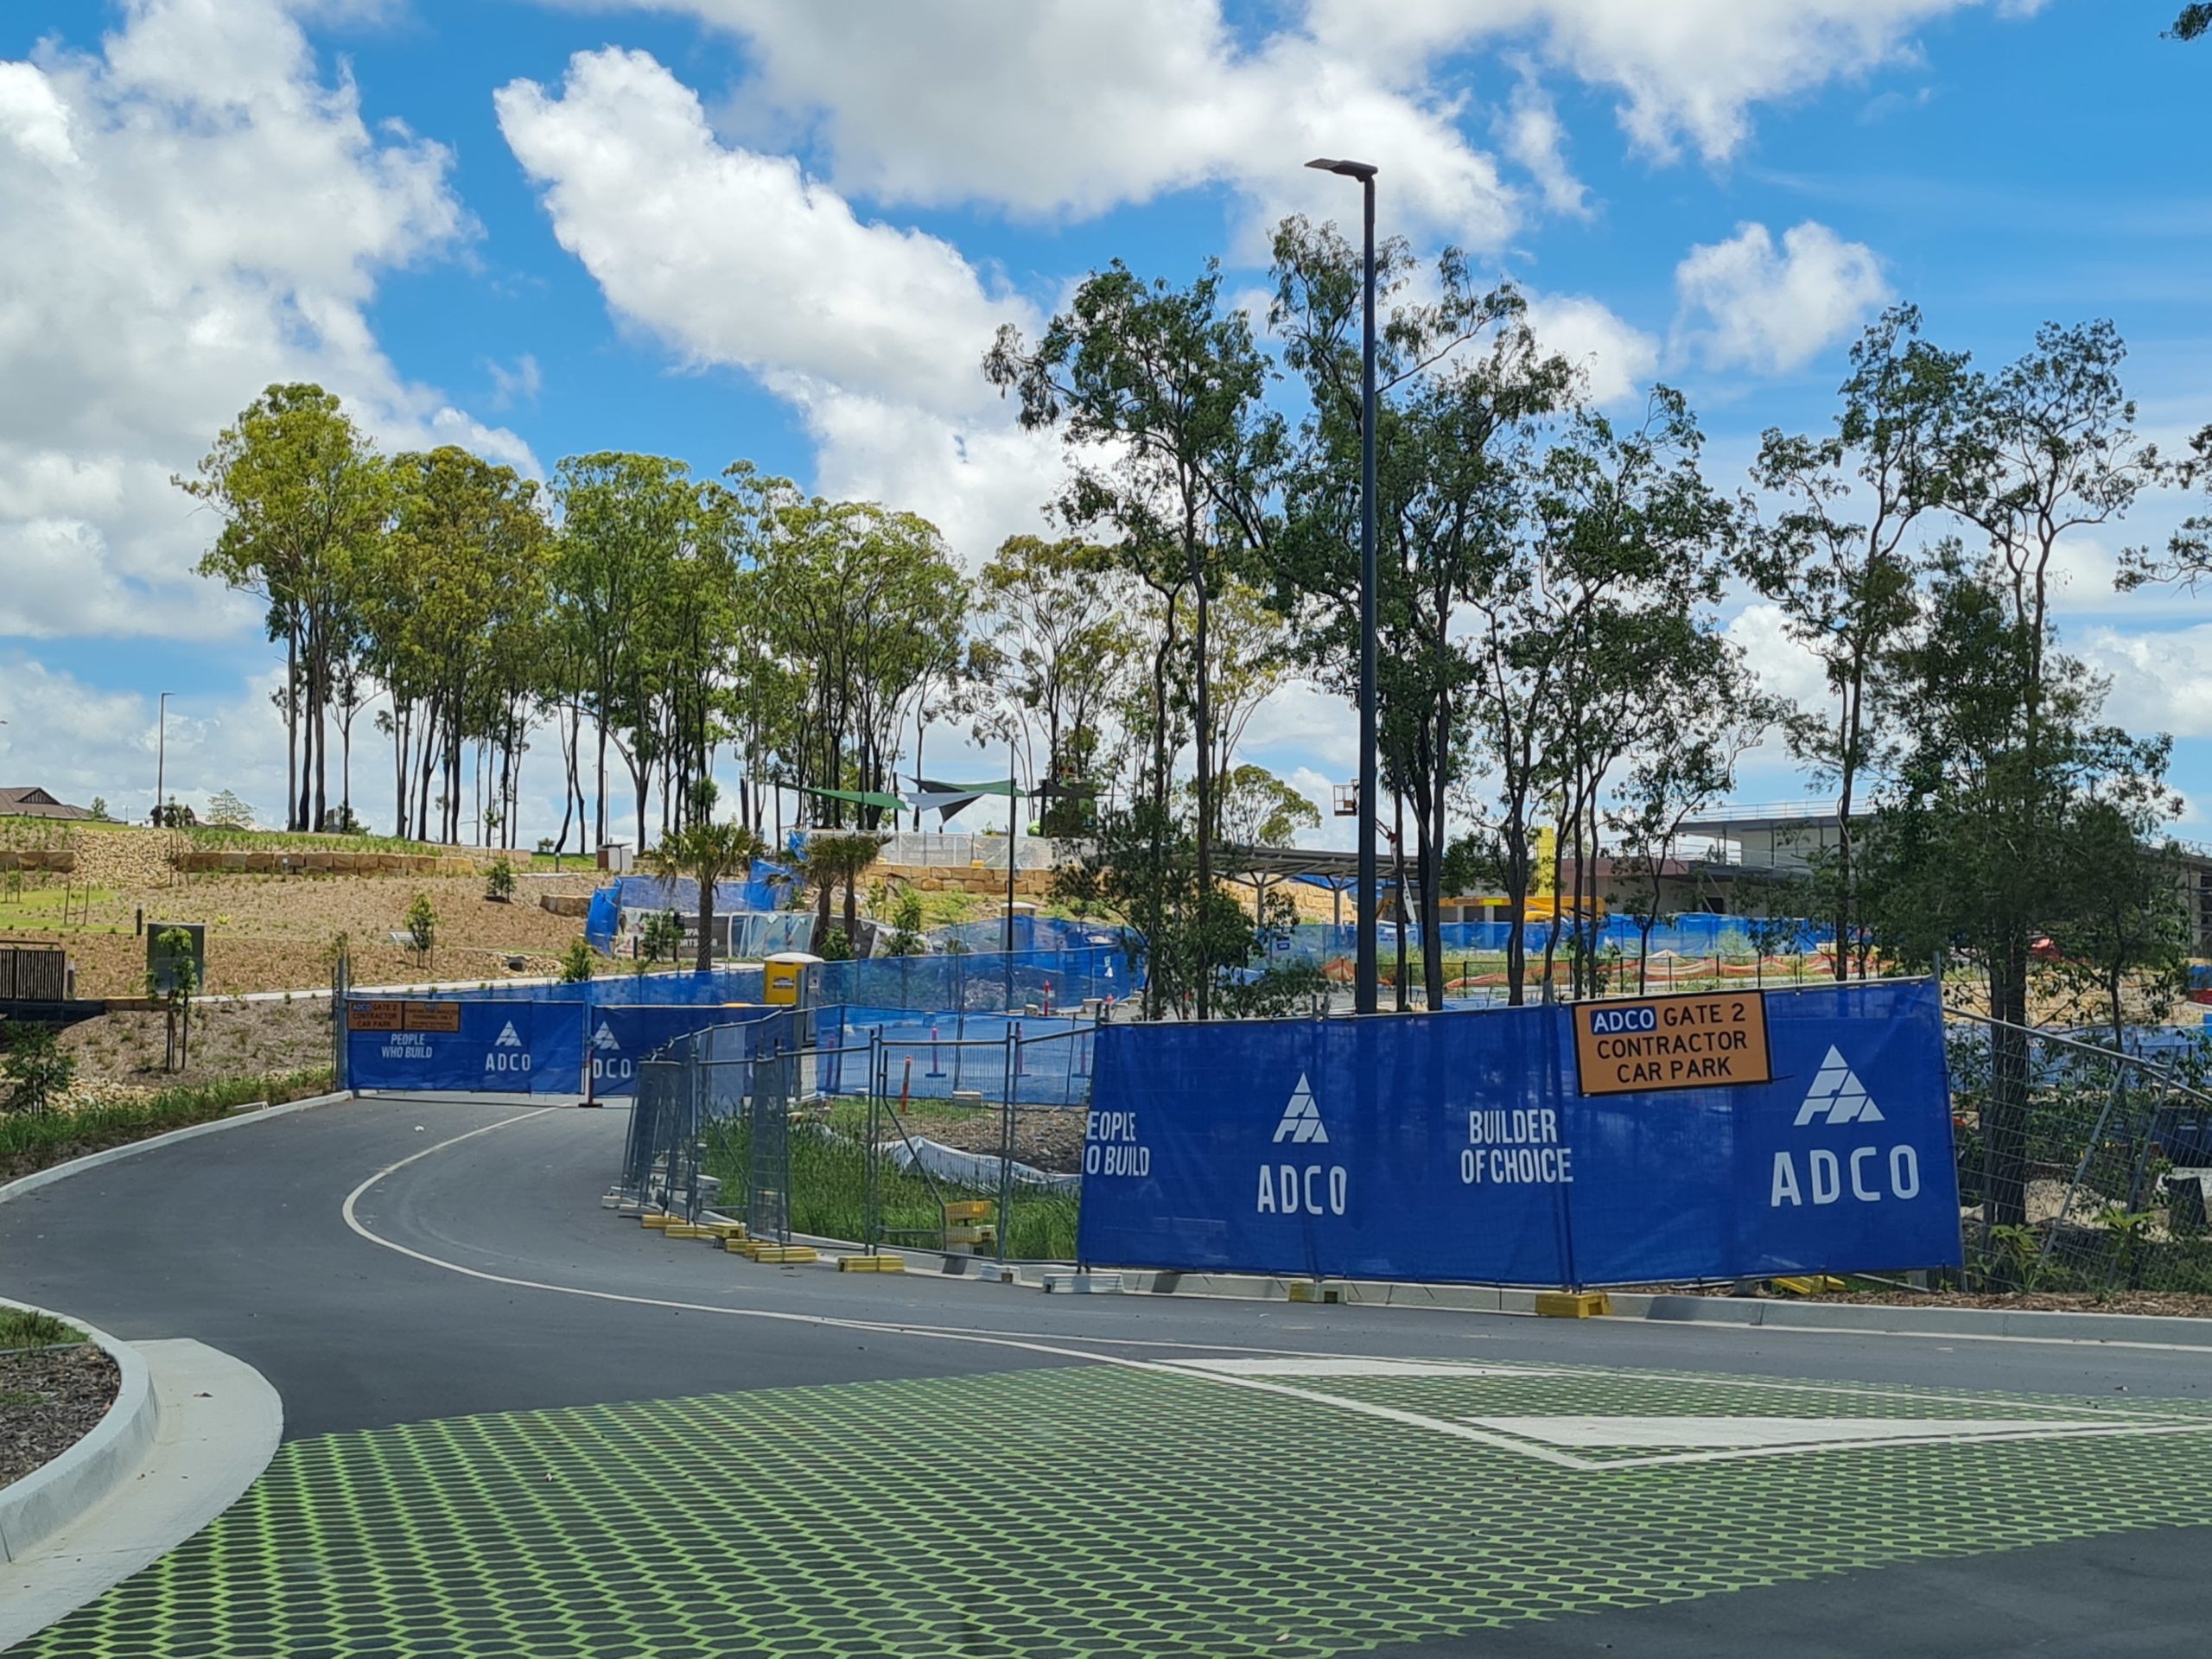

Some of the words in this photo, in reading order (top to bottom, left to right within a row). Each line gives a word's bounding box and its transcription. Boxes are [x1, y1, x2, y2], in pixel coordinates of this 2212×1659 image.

[1592, 1008, 1656, 1034] ADCO
[1663, 1003, 1724, 1027] GATE
[1731, 1002, 1746, 1022] 2
[381, 1046, 404, 1058] WHO
[404, 1046, 433, 1058] BUILD
[391, 1033, 426, 1046] PEOPLE
[1597, 1030, 1748, 1059] CONTRACTOR
[485, 1052, 531, 1072] ADCO
[592, 1058, 632, 1079] DCO
[1617, 1060, 1663, 1084] CAR
[1669, 1056, 1732, 1079] PARK
[1086, 1111, 1136, 1141] EOPLE
[1469, 1108, 1559, 1145] BUILDER
[1103, 1145, 1150, 1177] BUILD
[1460, 1148, 1486, 1184] OF
[1490, 1147, 1574, 1184] CHOICE
[1770, 1144, 1921, 1208] ADCO
[1257, 1164, 1348, 1216] ADCO
